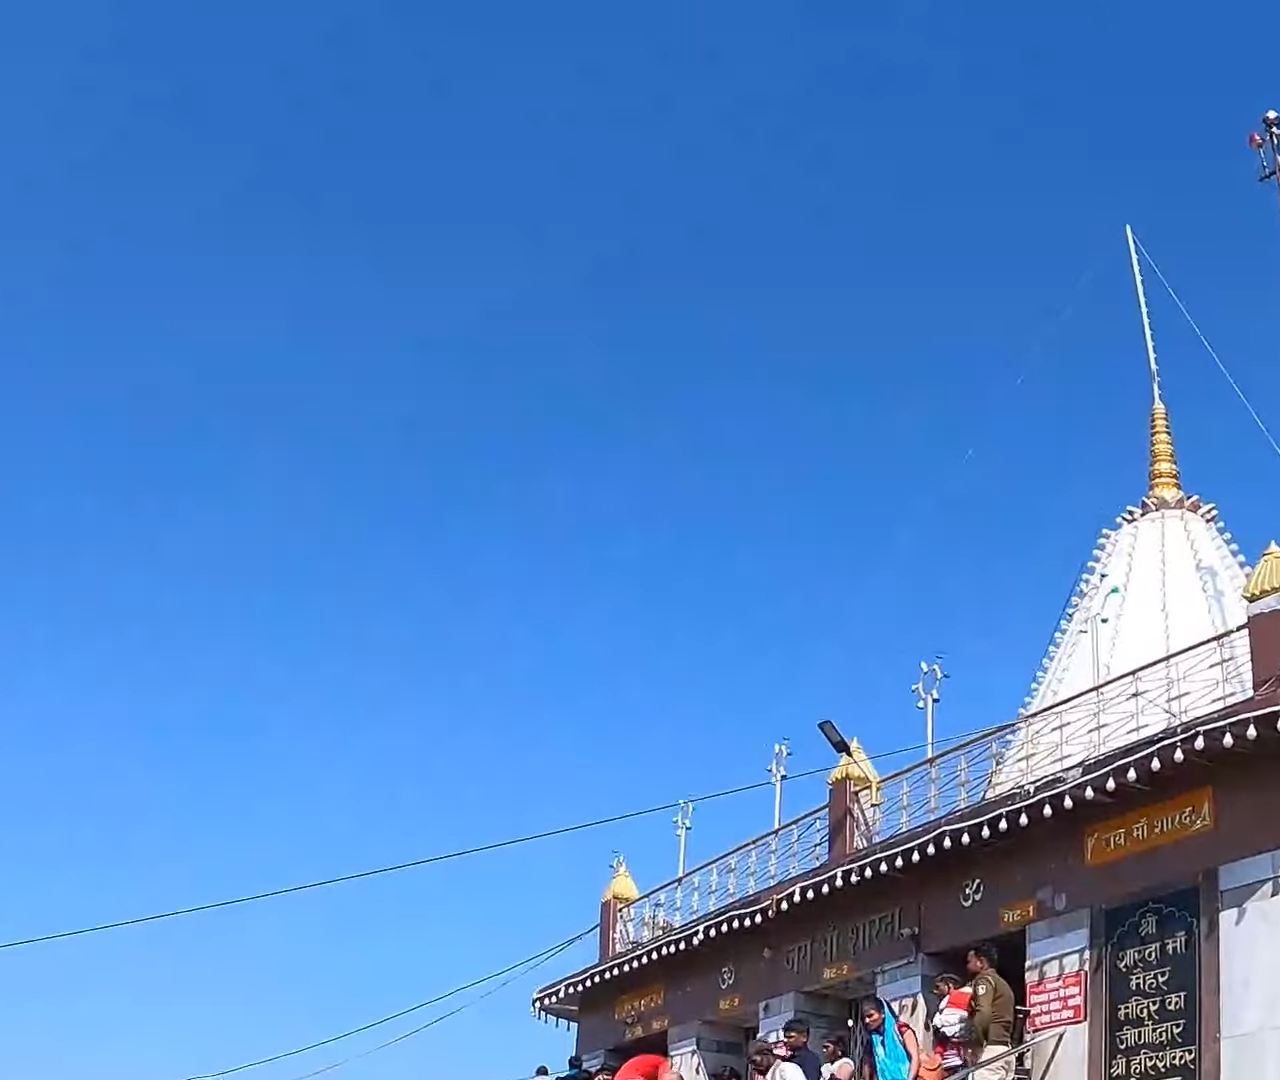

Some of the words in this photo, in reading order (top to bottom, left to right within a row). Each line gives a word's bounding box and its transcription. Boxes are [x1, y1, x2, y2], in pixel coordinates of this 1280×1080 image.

[1138, 912, 1158, 937] श्री
[1116, 942, 1162, 972] शारदा
[1117, 996, 1163, 1021] मंदिर
[1164, 991, 1188, 1012] का
[1110, 1054, 1127, 1077] श्री
[1128, 1046, 1197, 1077] हरिशंकर
